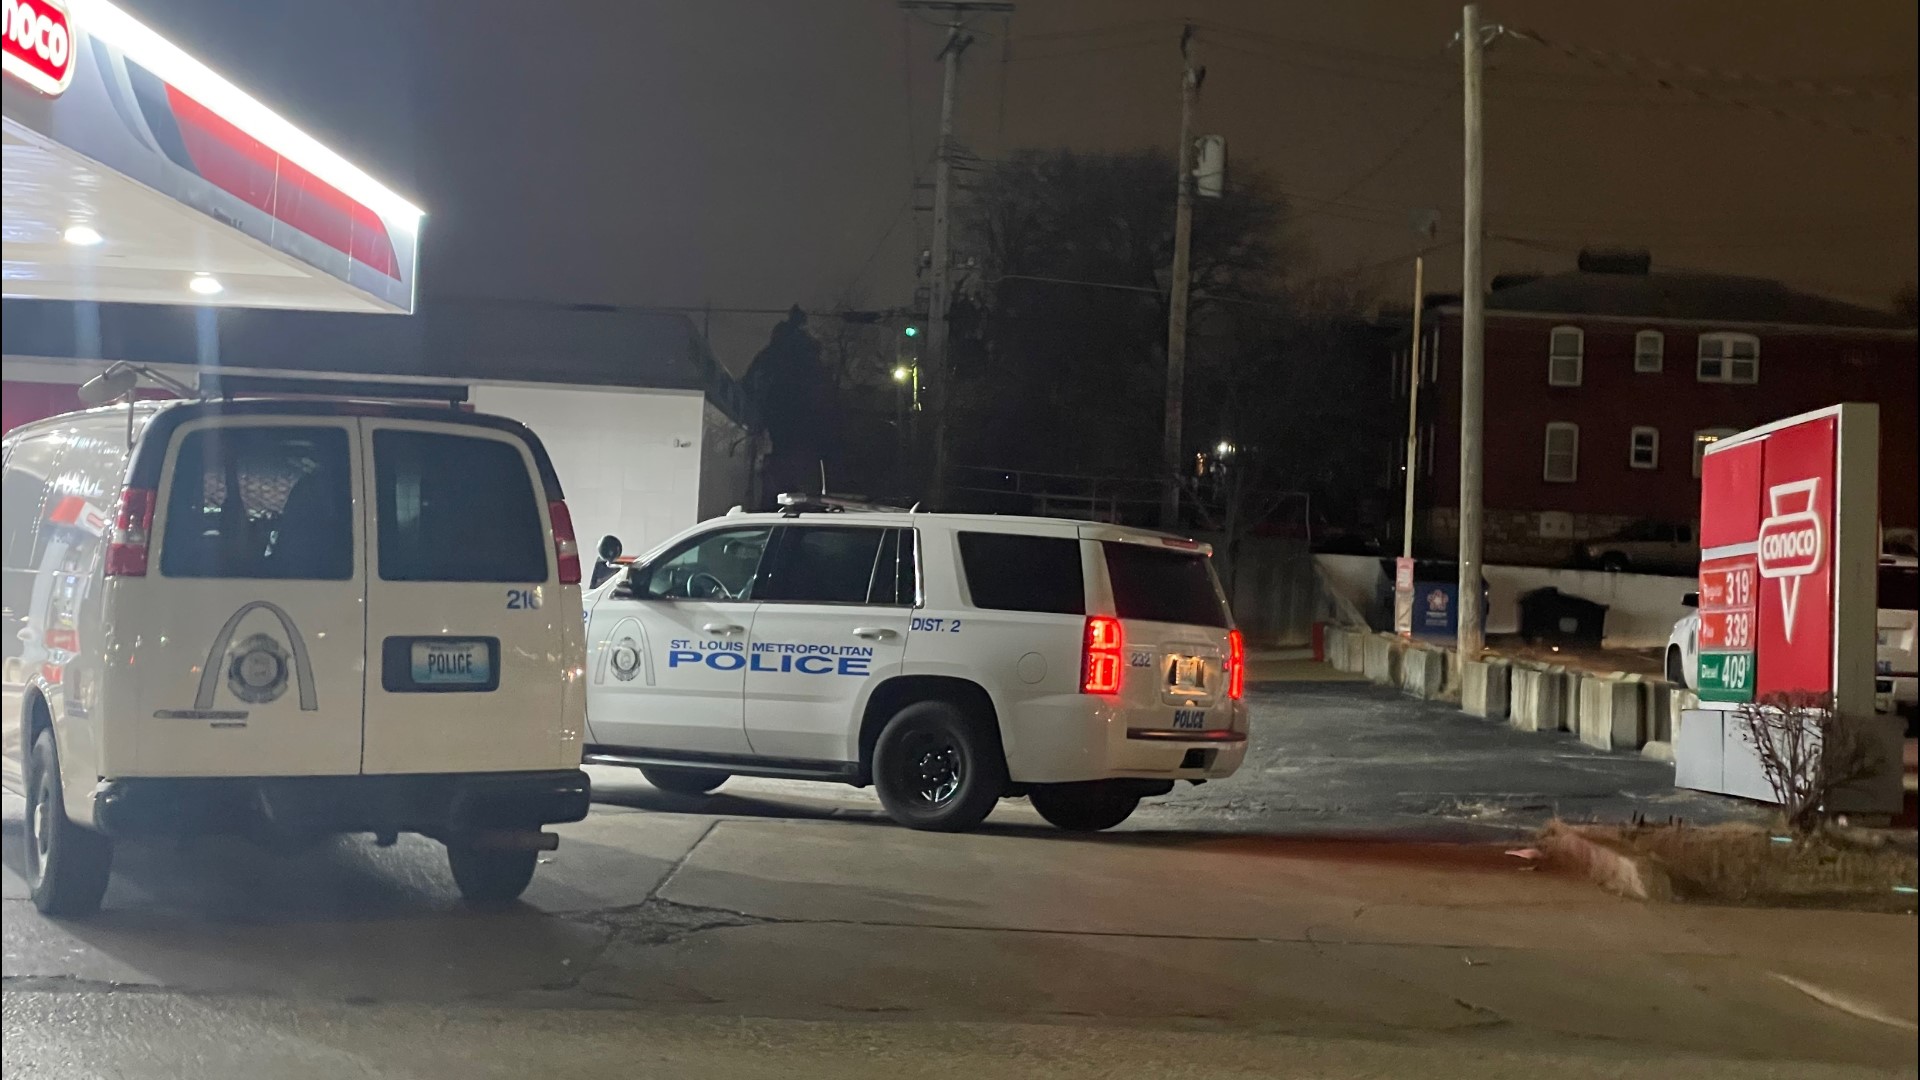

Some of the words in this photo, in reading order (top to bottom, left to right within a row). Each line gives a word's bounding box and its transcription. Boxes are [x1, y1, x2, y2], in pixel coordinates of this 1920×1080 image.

[911, 618, 944, 632] DIST.
[950, 619, 961, 633] 2
[670, 639, 692, 650] ST.
[699, 640, 744, 651] LOUIS
[752, 642, 873, 657] METROPOLITAN
[428, 653, 473, 675] POLICE
[668, 650, 871, 676] POLICE
[1131, 652, 1151, 668] 232
[1174, 710, 1204, 729] POLICE
